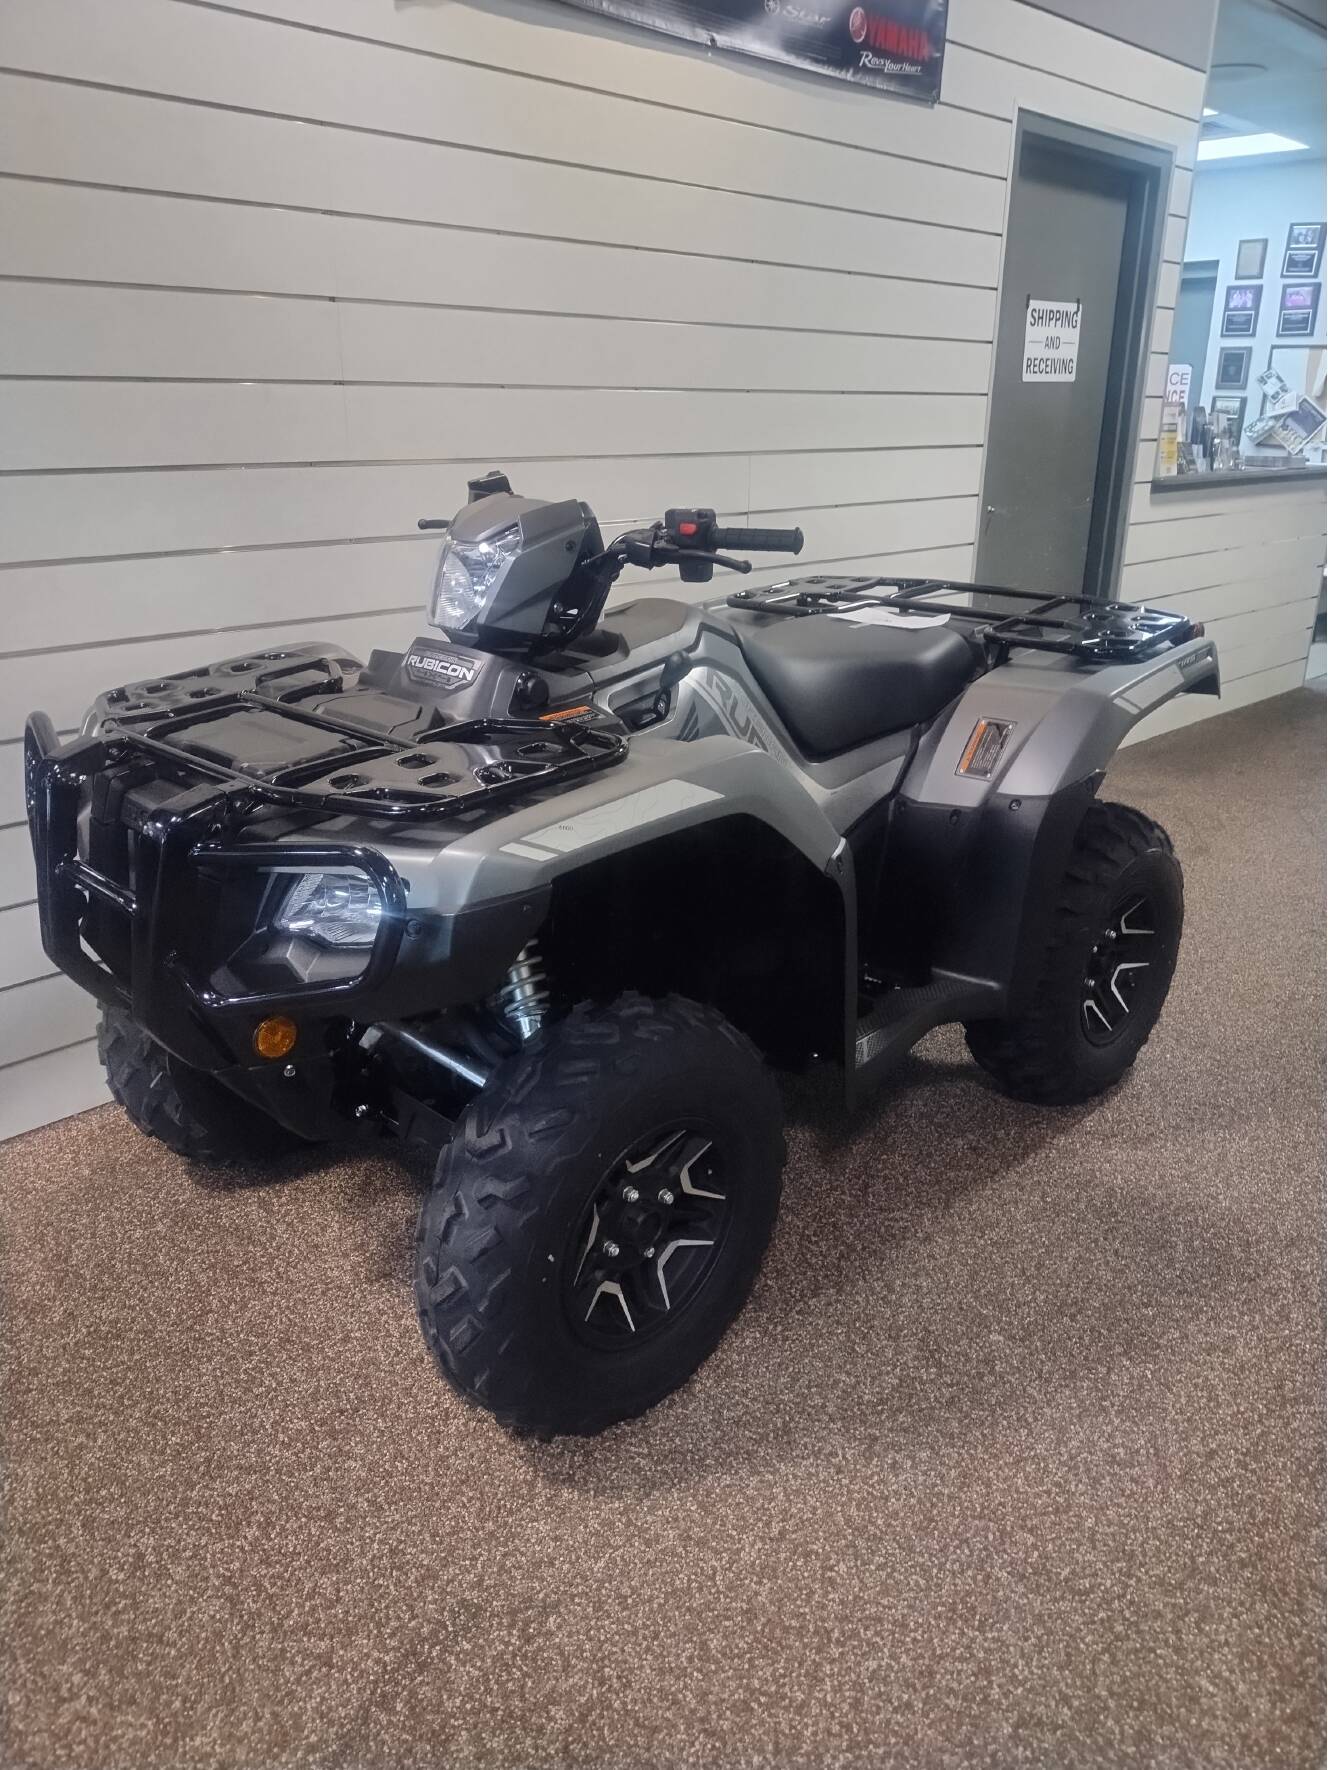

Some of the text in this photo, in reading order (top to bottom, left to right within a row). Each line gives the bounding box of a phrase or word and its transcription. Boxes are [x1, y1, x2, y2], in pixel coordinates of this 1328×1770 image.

[868, 15, 930, 62] YAMAHA
[1030, 308, 1078, 328] SHIPPING
[1044, 336, 1061, 350] AND
[1026, 357, 1074, 375] RECEIVING
[407, 655, 475, 681] RUBICON
